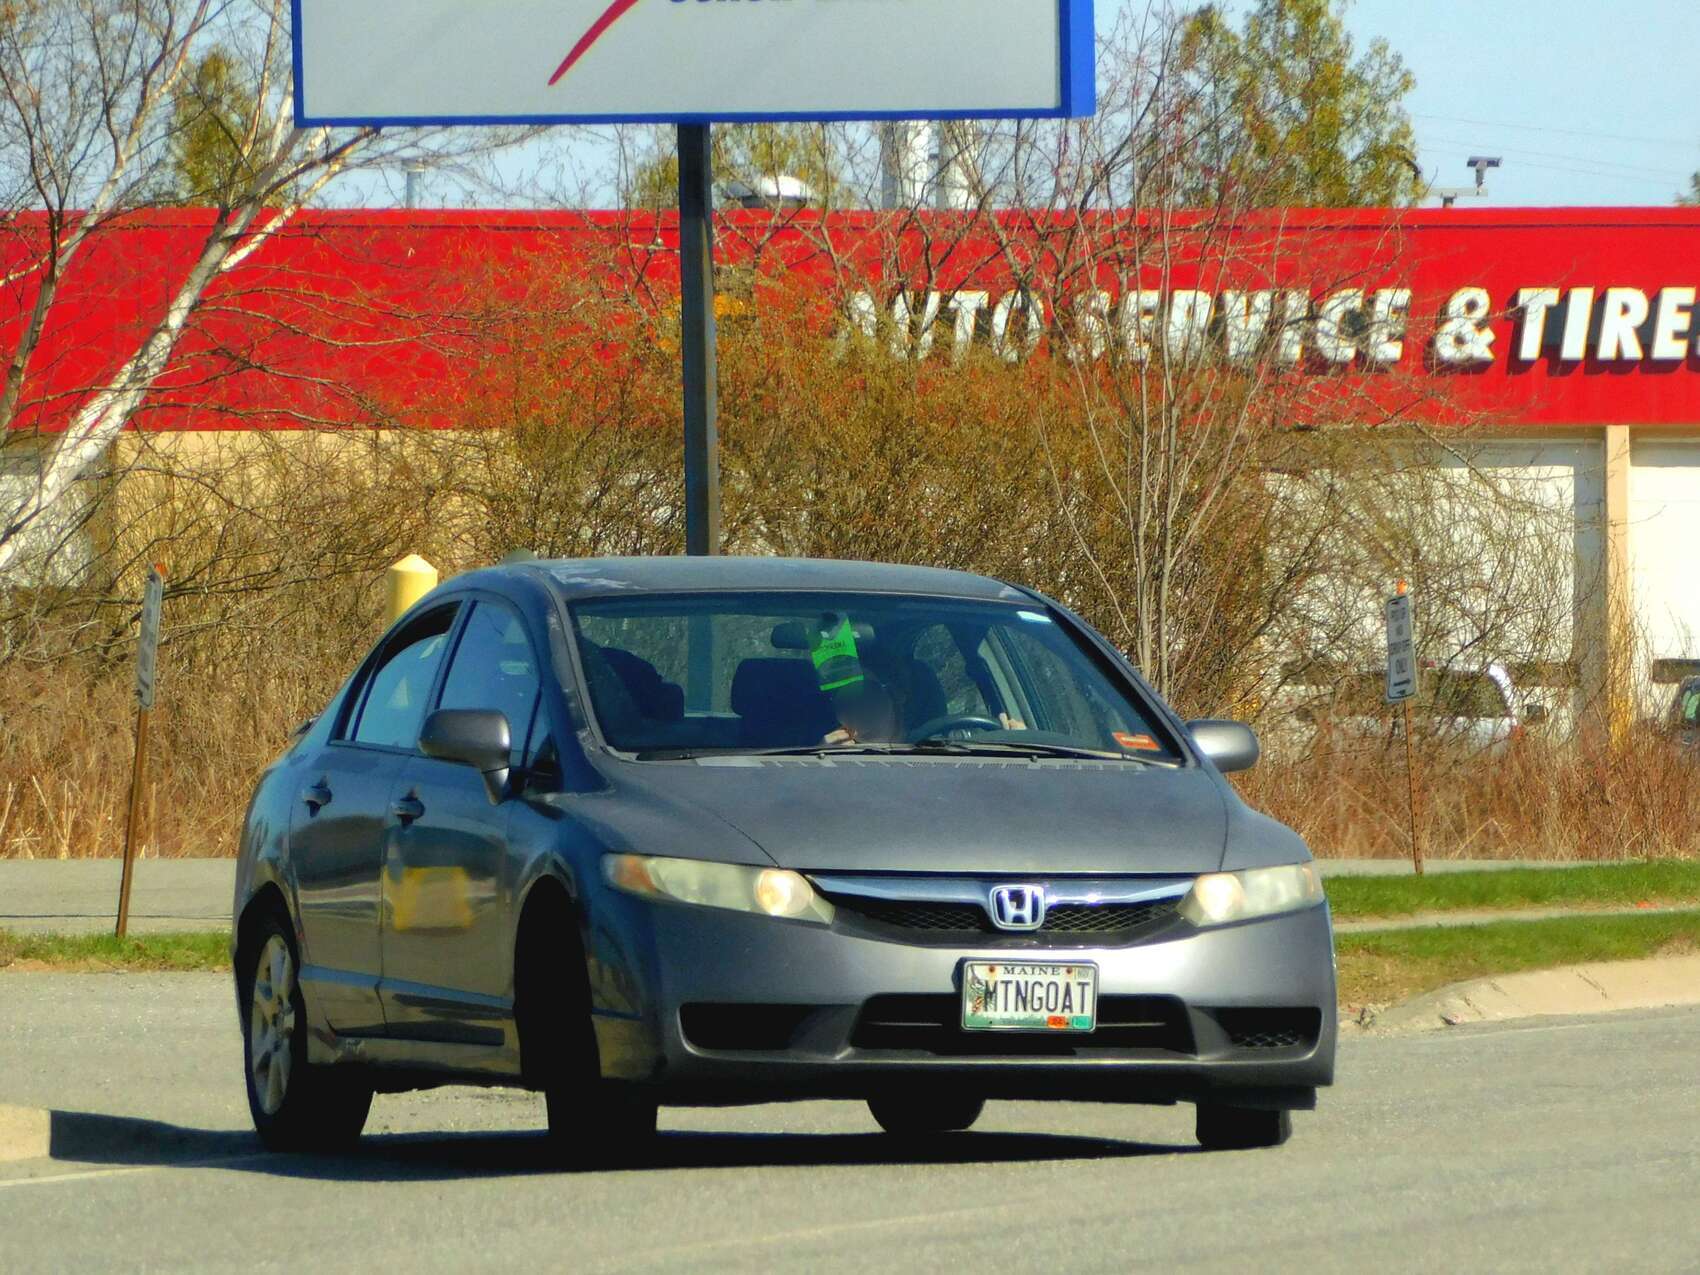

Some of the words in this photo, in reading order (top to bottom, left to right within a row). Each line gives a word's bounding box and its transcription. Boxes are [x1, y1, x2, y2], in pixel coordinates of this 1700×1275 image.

[1434, 287, 1495, 361] &
[1517, 288, 1700, 360] TIRE
[1003, 966, 1061, 976] MAINE
[984, 980, 1090, 1014] MTNGOAT
